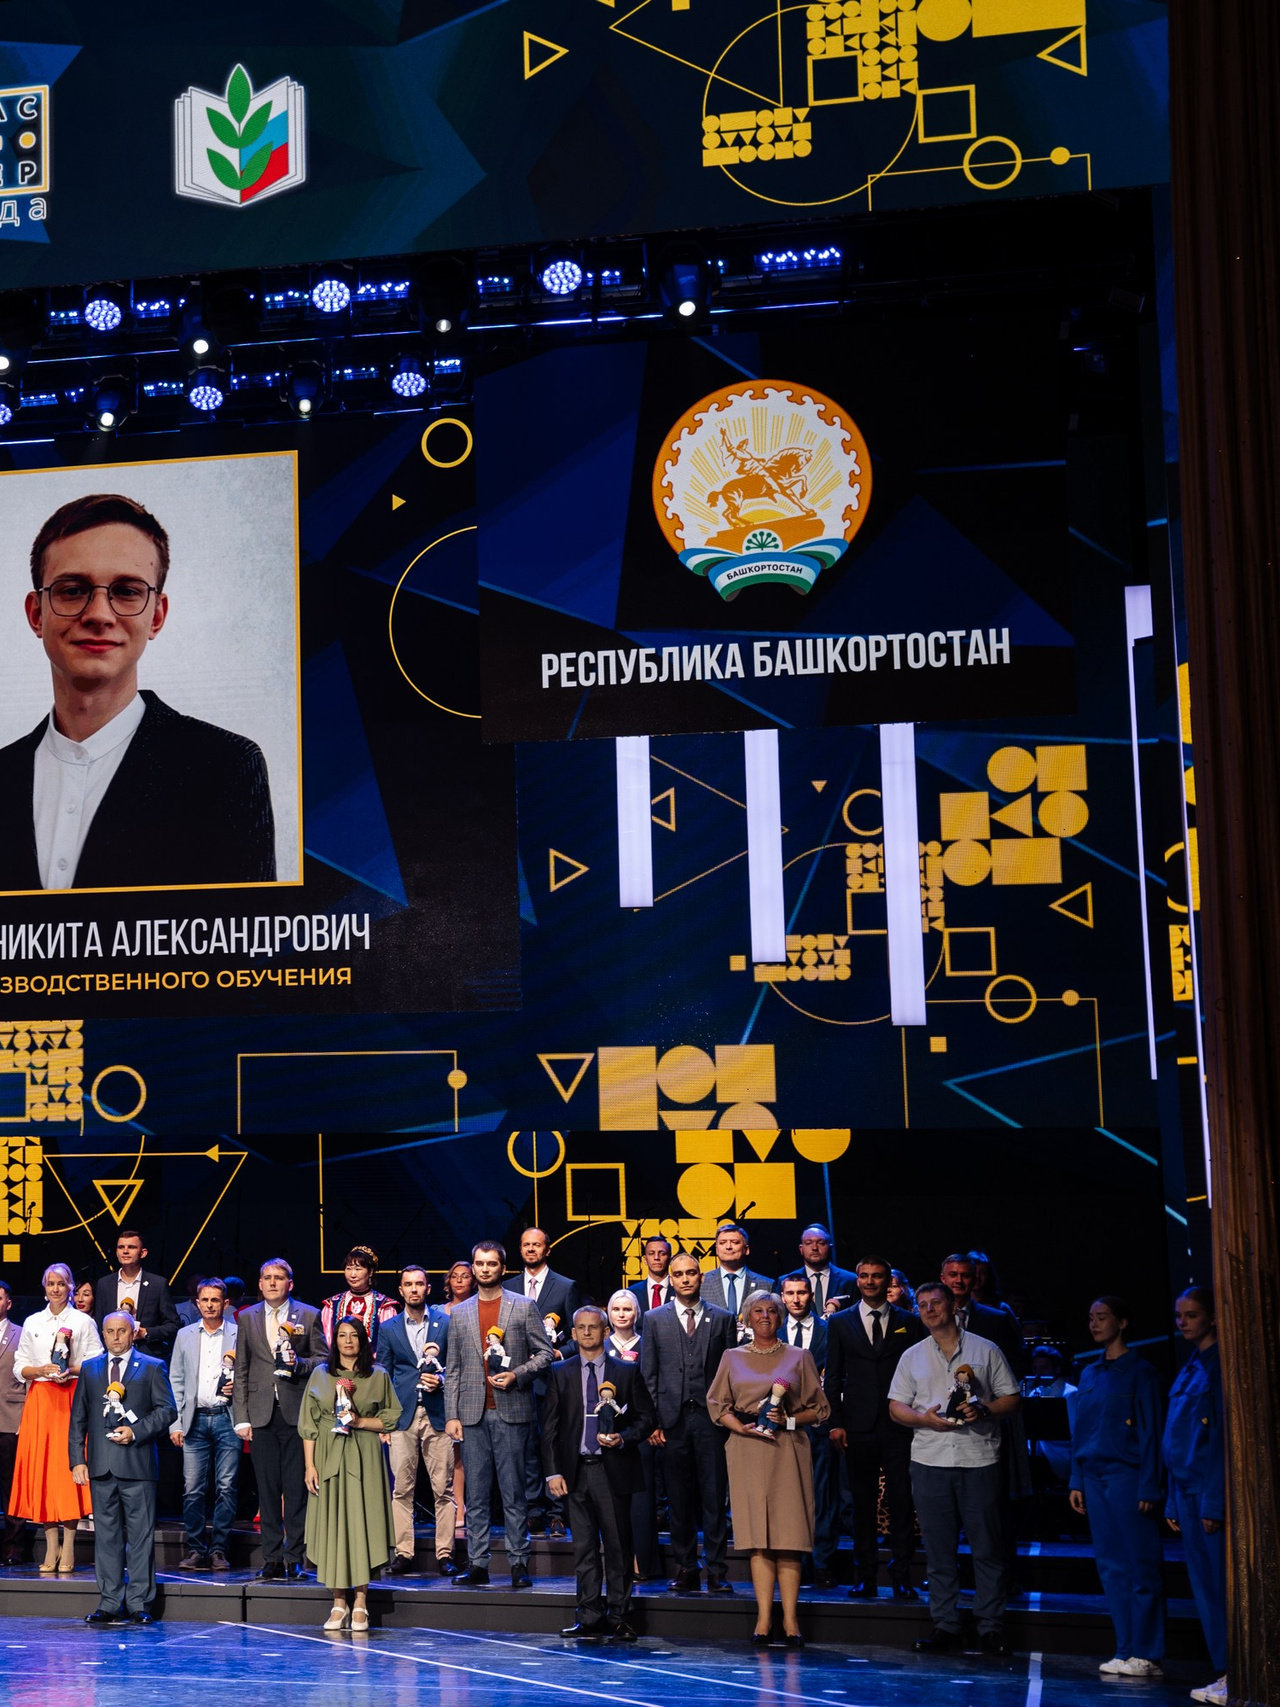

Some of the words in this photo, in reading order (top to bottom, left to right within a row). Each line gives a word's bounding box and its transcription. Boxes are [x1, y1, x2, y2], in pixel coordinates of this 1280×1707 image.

[541, 642, 745, 689] РЕСПУБЛИКА
[753, 627, 1011, 678] БАШКОРТОСТАН
[111, 913, 370, 958] АЛЕКСАНДРОВИЧ
[216, 967, 352, 989] ОБУЧЕНИЯ
